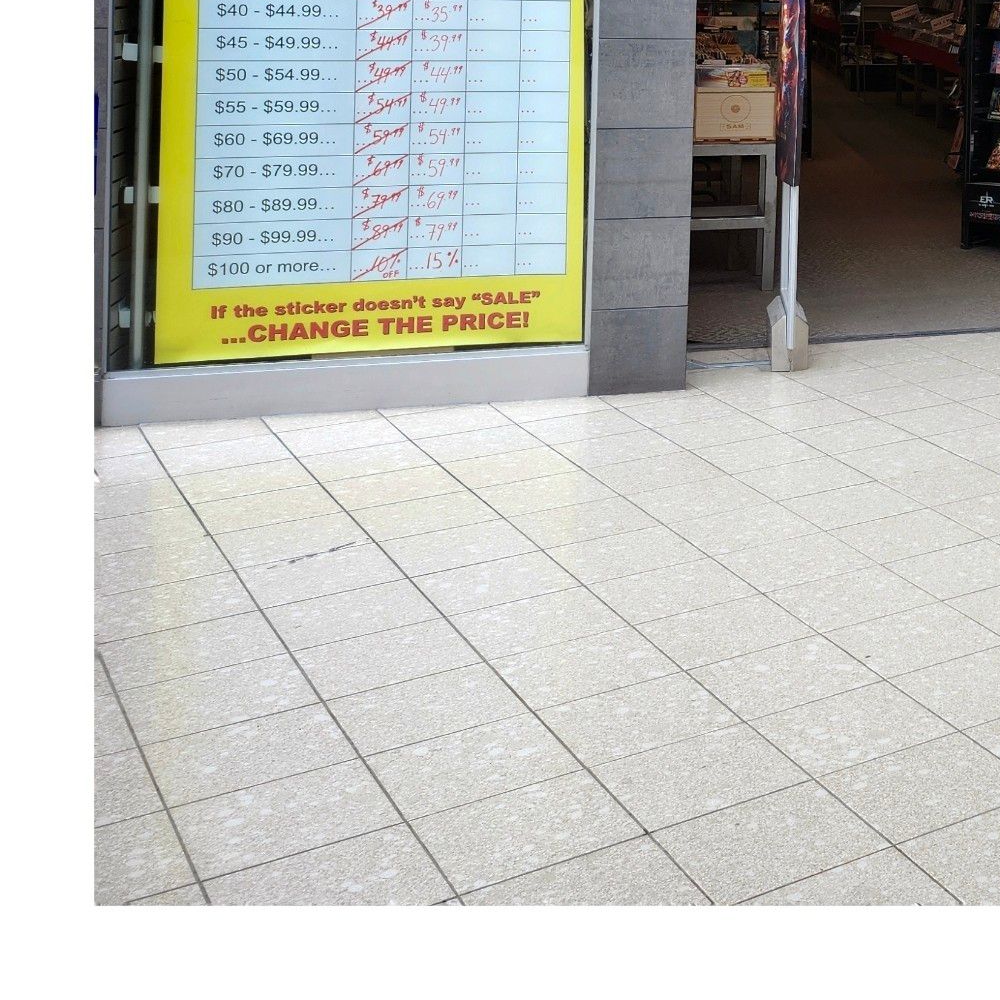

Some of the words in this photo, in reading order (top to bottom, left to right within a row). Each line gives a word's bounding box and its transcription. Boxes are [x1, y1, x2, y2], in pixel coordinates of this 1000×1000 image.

[217, 3, 248, 17] $40
[216, 35, 247, 49] $45
[216, 68, 246, 82] $50
[215, 100, 246, 114] $55
[214, 133, 246, 146] $60
[213, 165, 245, 179] $70
[213, 199, 243, 214] $80
[212, 232, 243, 246] $90
[427, 249, 459, 270] 15%
[208, 262, 249, 277] $100
[255, 264, 273, 275] or
[383, 270, 399, 279] OFF
[210, 305, 227, 320] If
[234, 304, 268, 319] the
[273, 301, 348, 316] sticker
[432, 295, 465, 310] say
[377, 316, 432, 335] THE
[442, 311, 530, 332] PRICE!
